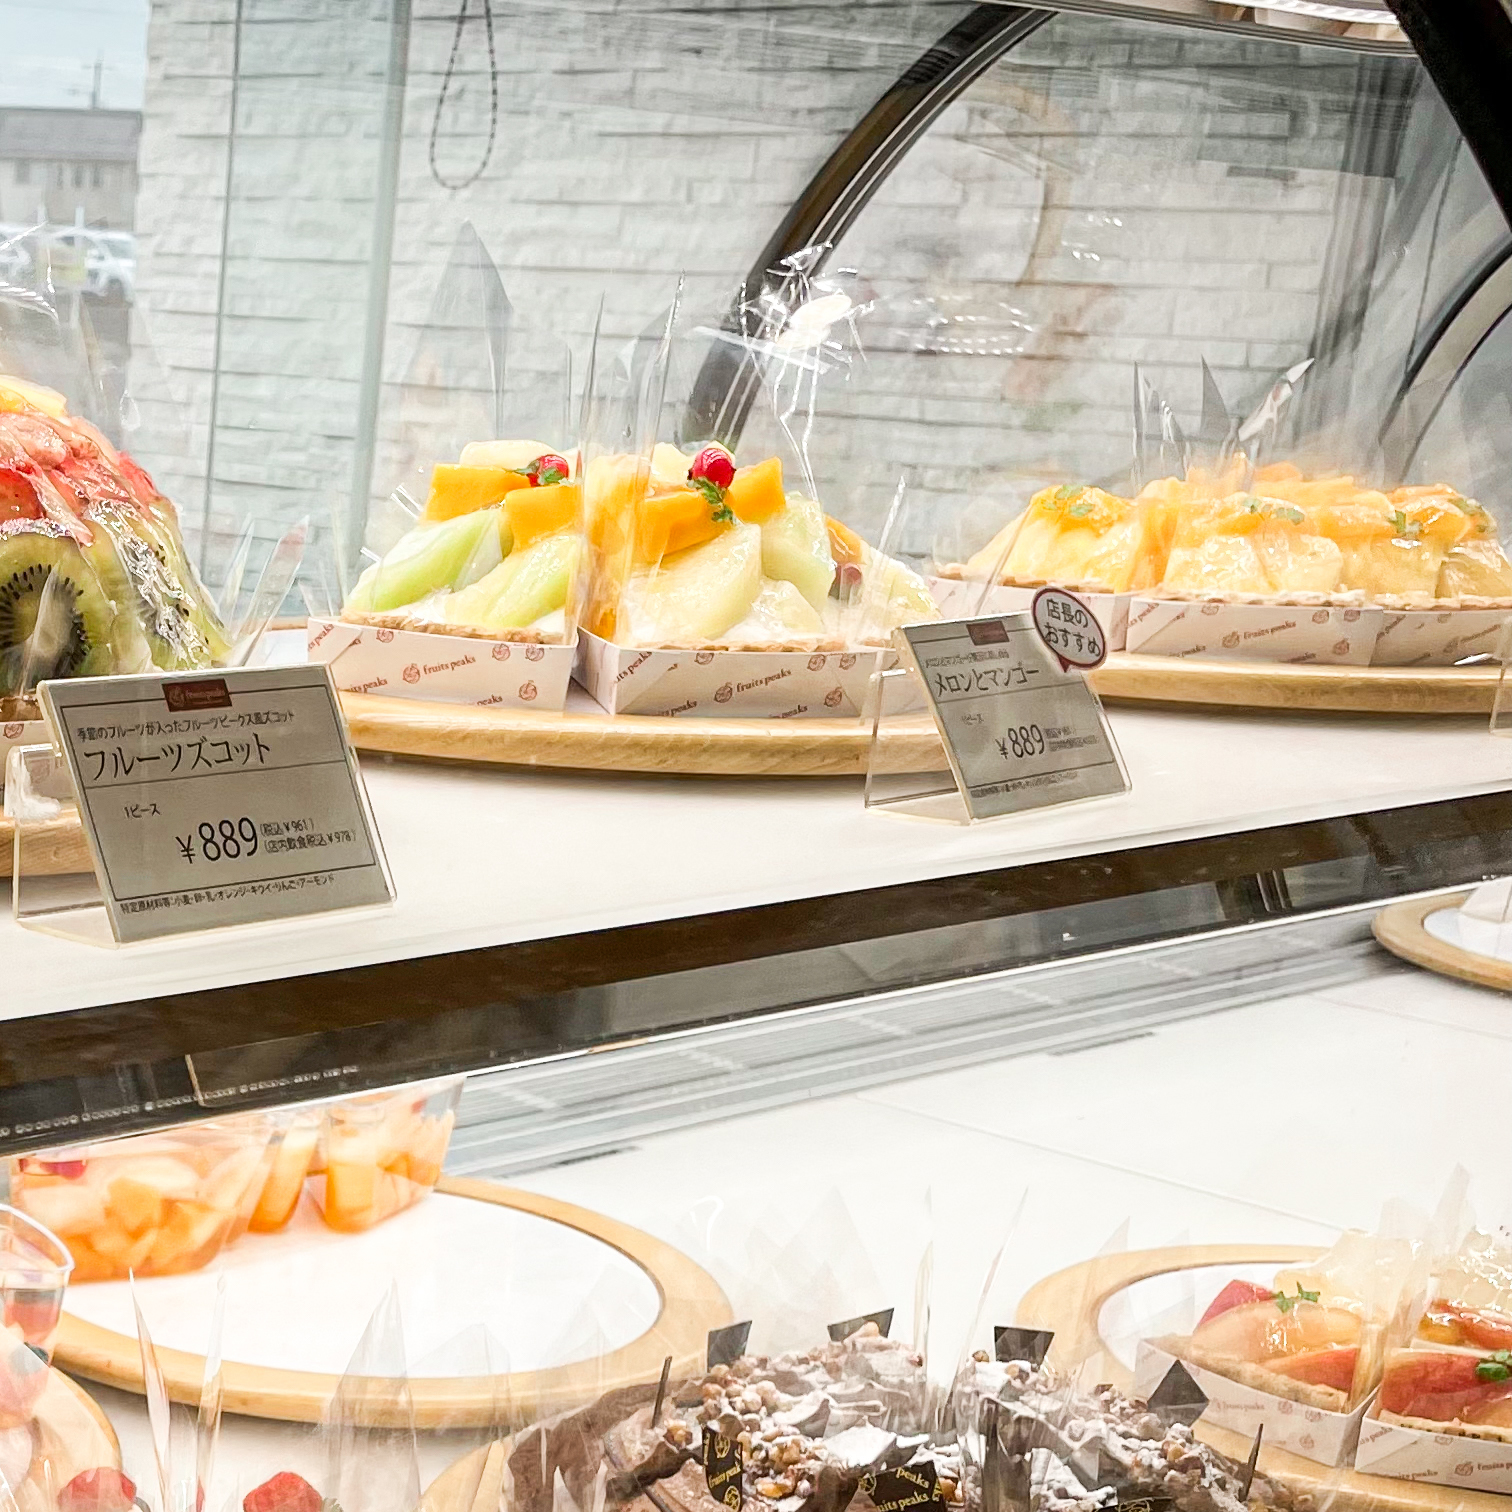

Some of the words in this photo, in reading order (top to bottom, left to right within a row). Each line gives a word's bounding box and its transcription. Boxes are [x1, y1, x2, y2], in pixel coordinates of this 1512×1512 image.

[1046, 598, 1089, 628] 店長の
[1043, 622, 1101, 657] おすすめ
[449, 655, 476, 671] peaks
[764, 668, 792, 686] peaks
[934, 661, 1039, 697] メロンとマンゴー
[83, 732, 271, 781] フルーツズコット
[994, 723, 1046, 761] ¥889
[174, 816, 259, 864] ¥889
[895, 1466, 930, 1489] peaks
[898, 1490, 930, 1511] peaks
